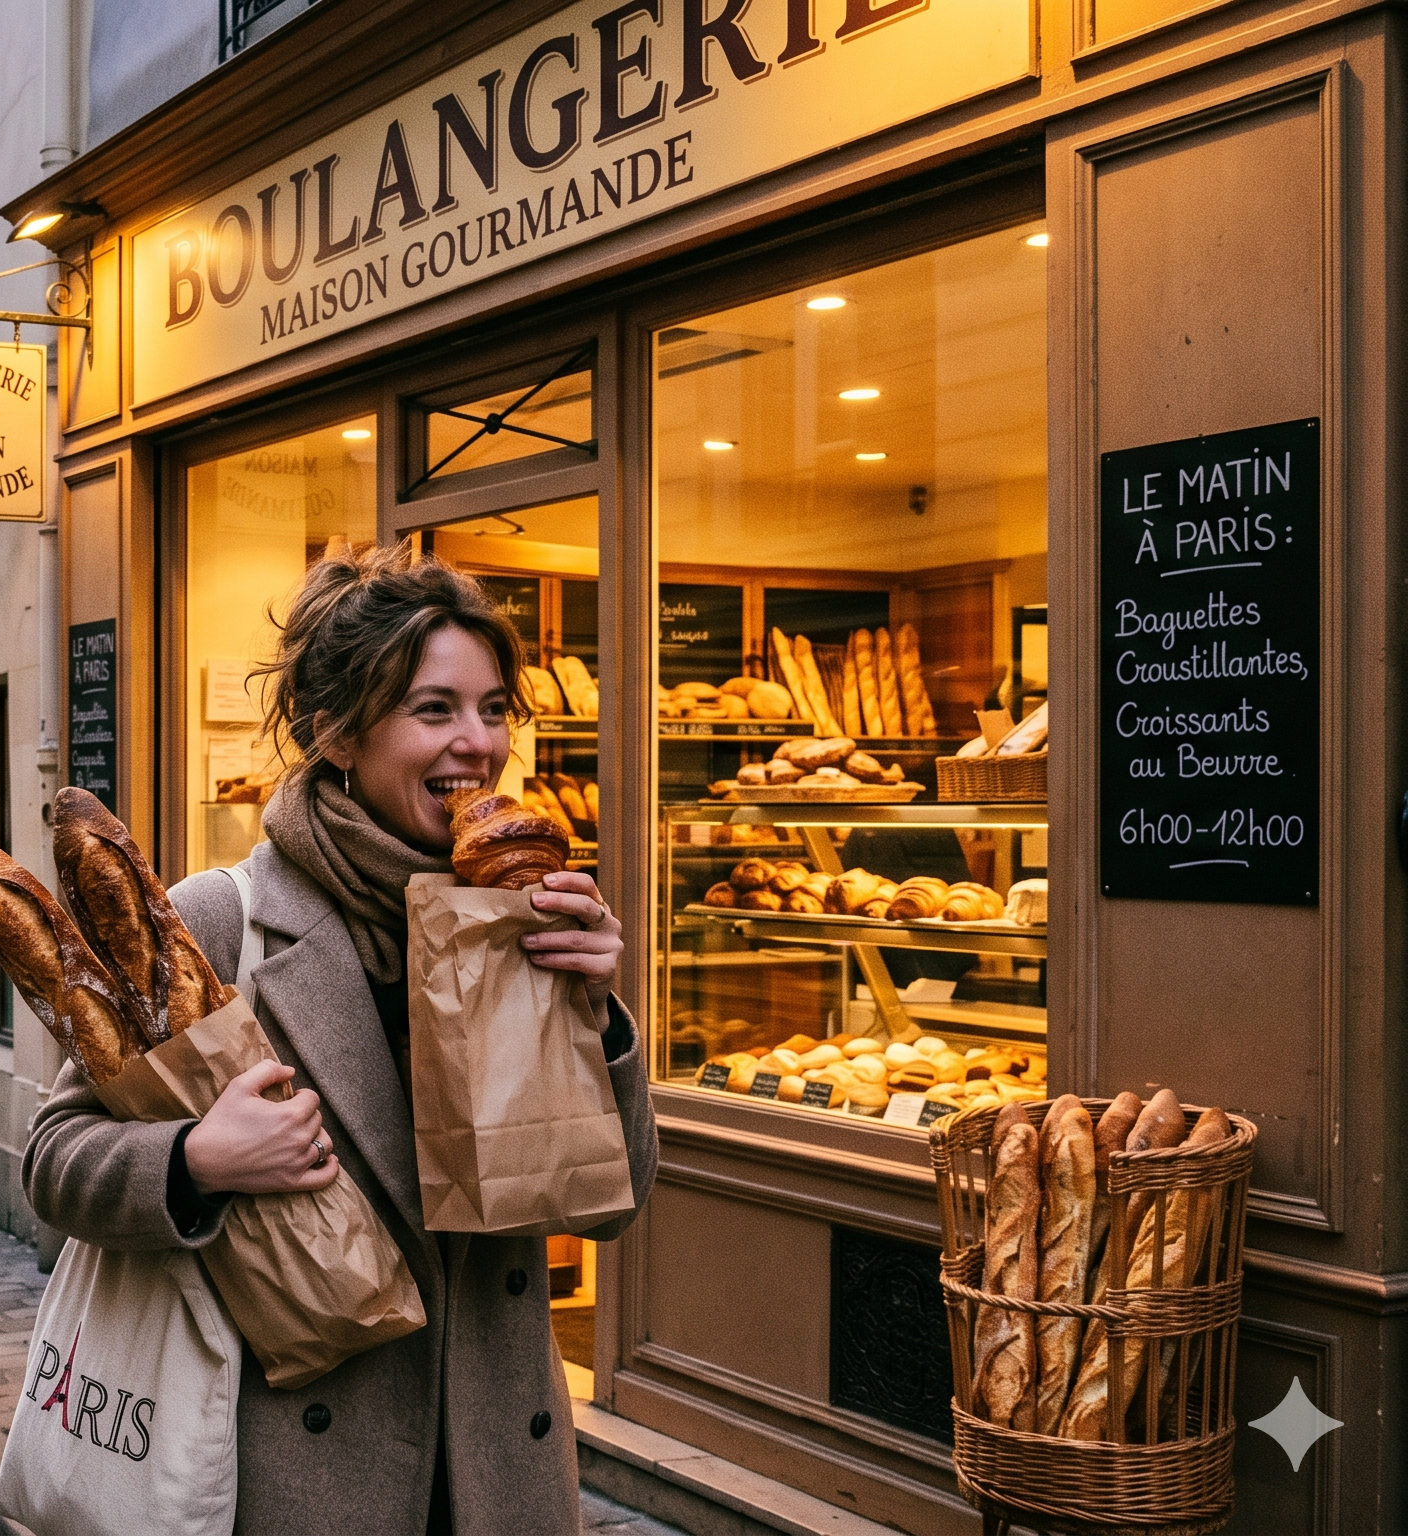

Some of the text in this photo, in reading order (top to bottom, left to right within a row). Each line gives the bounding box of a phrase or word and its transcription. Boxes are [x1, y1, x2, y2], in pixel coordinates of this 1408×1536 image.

[164, 0, 929, 332] BOULANGER
[260, 129, 694, 345] MAISON GOURMANDE
[1123, 472, 1163, 514] LE
[1134, 518, 1159, 564] À
[1114, 591, 1261, 650] Baguettes
[73, 637, 84, 657] LE
[1116, 638, 1309, 685] Croustillantes,
[1116, 698, 1270, 737] Croissants
[1129, 758, 1165, 778] au
[1119, 808, 1304, 846] 6h00-12h00
[26, 1321, 156, 1461] PARIS
